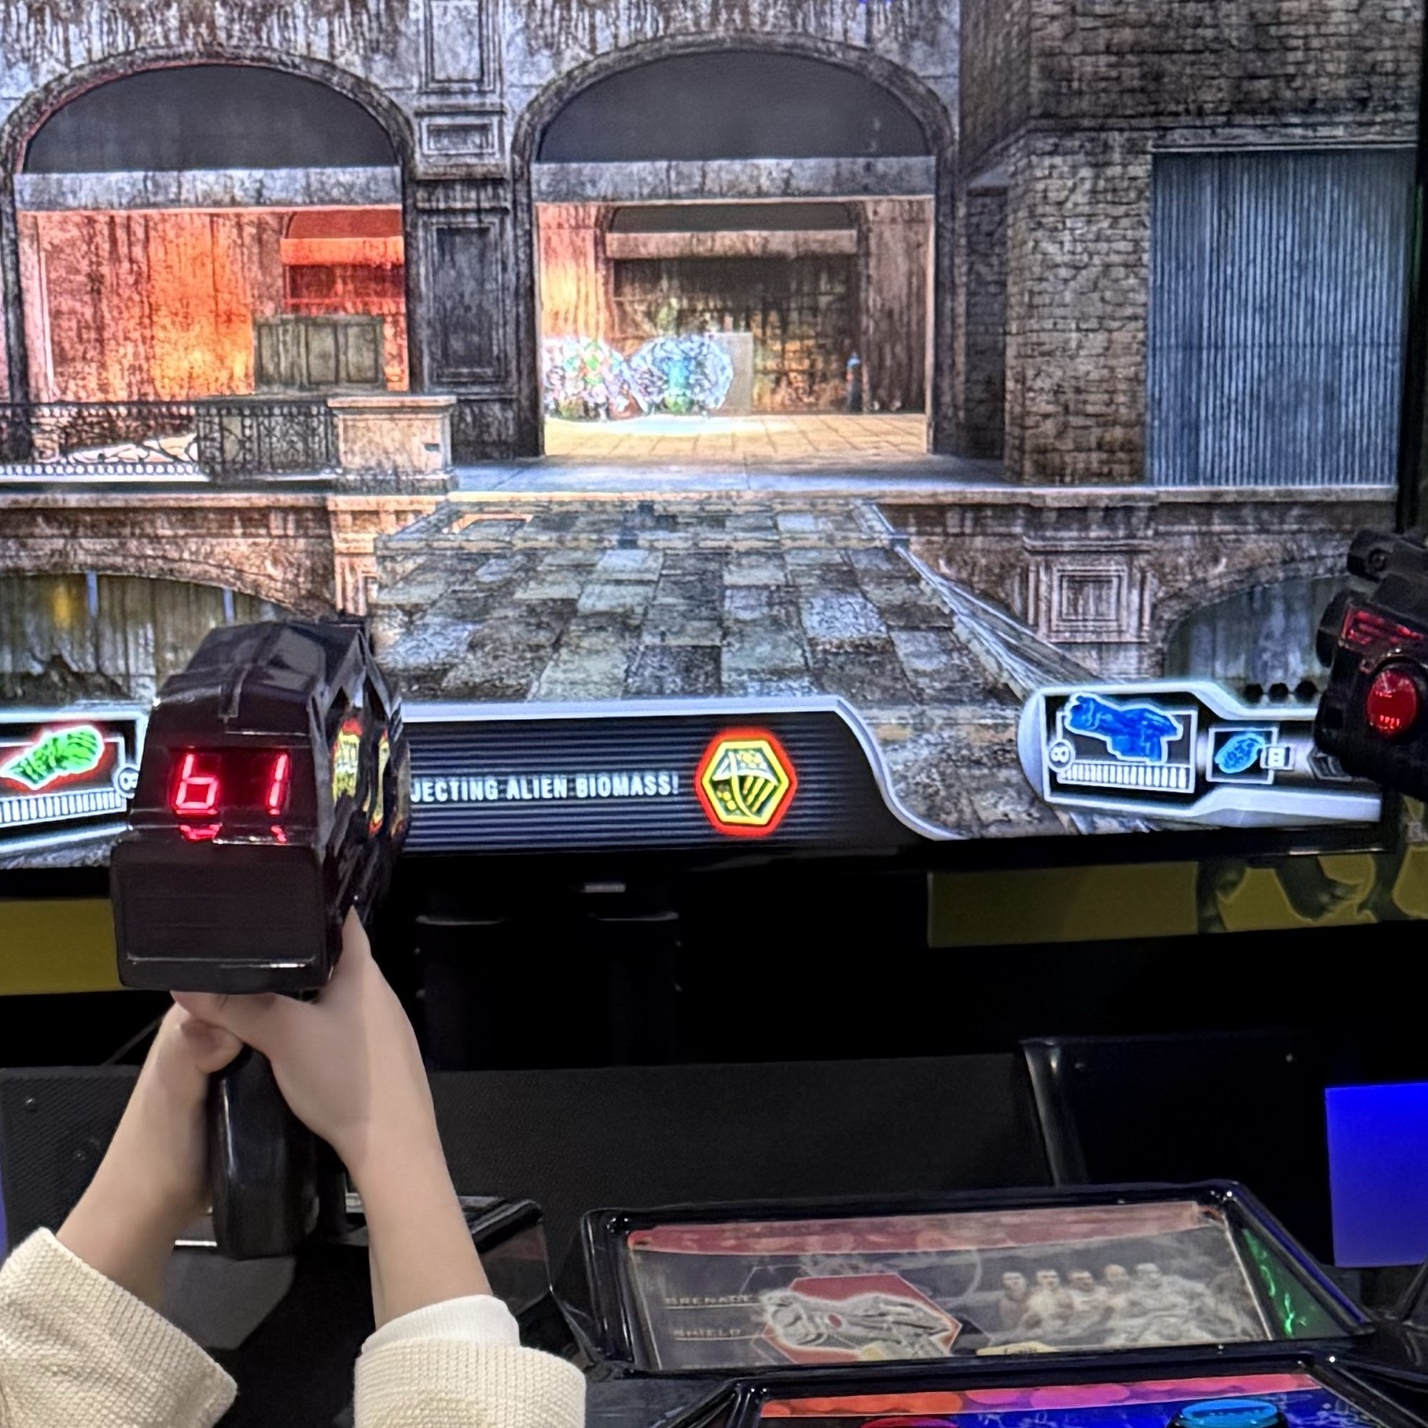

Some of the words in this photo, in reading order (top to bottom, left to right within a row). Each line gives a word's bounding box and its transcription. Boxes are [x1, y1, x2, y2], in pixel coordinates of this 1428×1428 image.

[410, 776, 499, 802] JECTING
[506, 774, 568, 799] ALIEN
[575, 770, 679, 798] BIOMASS!
